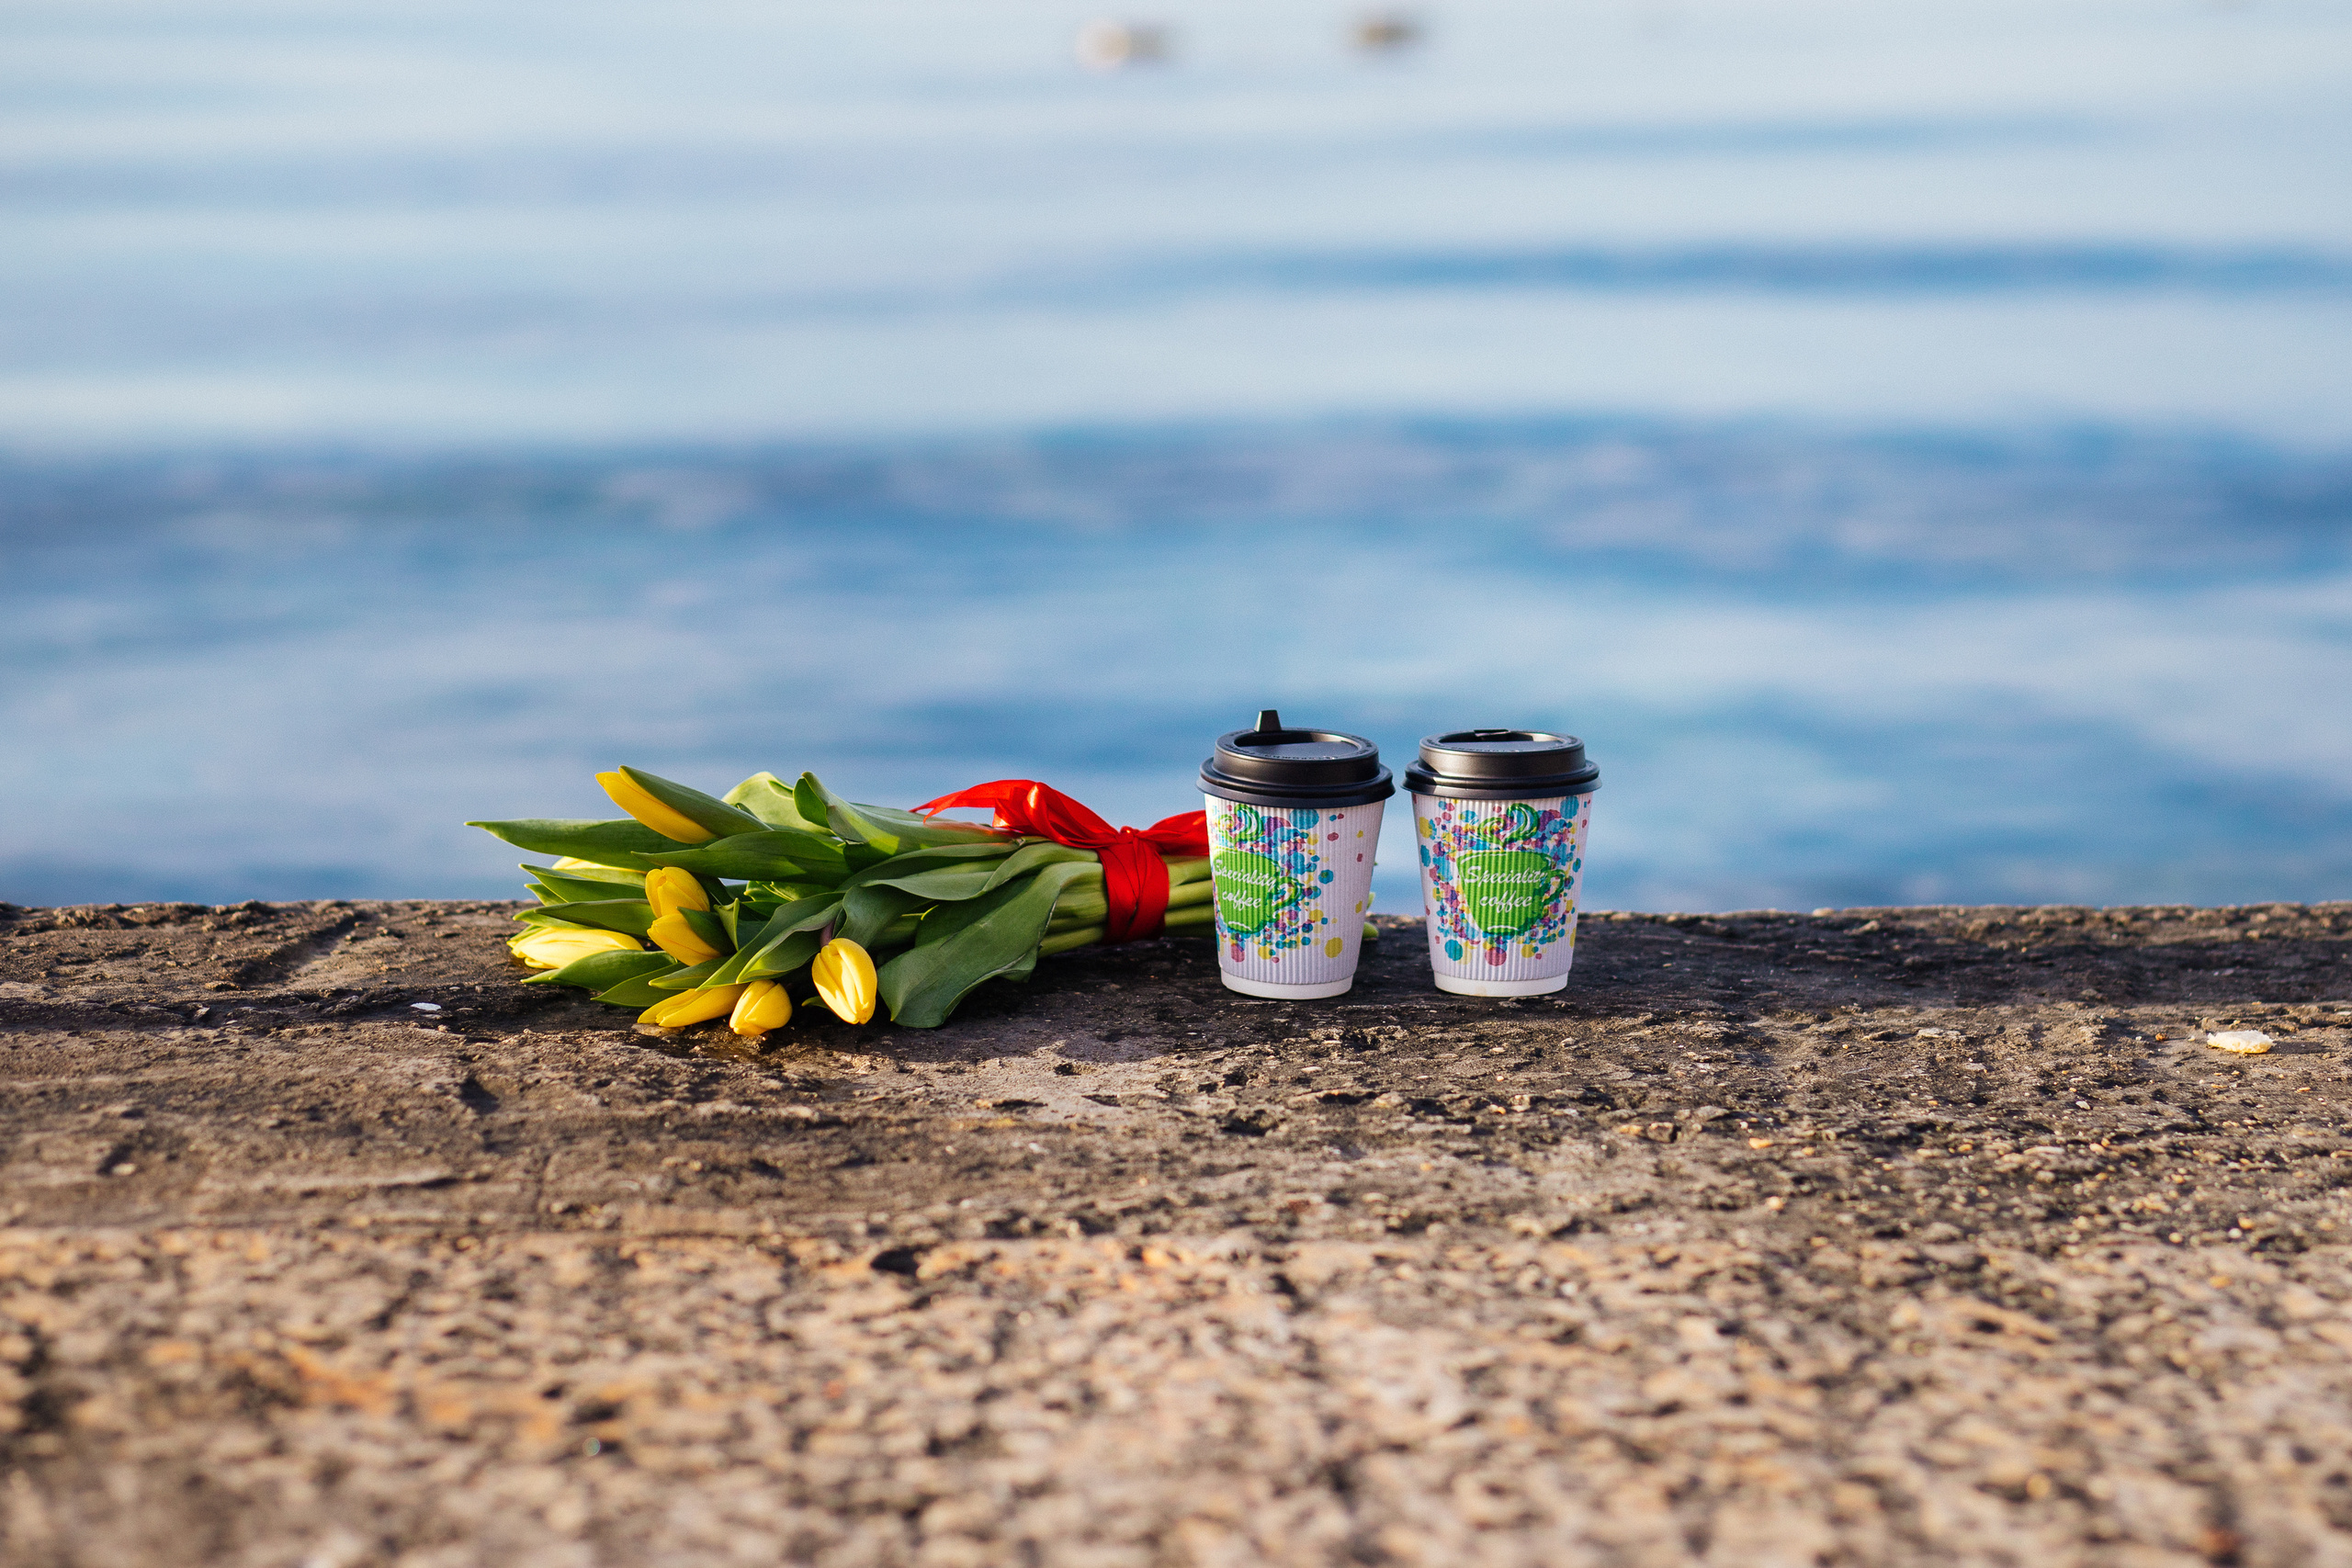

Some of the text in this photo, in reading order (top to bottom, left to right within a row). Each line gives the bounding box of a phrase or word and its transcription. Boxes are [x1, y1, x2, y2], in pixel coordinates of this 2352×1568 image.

[1215, 860, 1277, 891] Speciality
[1464, 866, 1548, 887] Speciality
[1222, 889, 1262, 910] coffee
[1479, 890, 1532, 913] coffee
